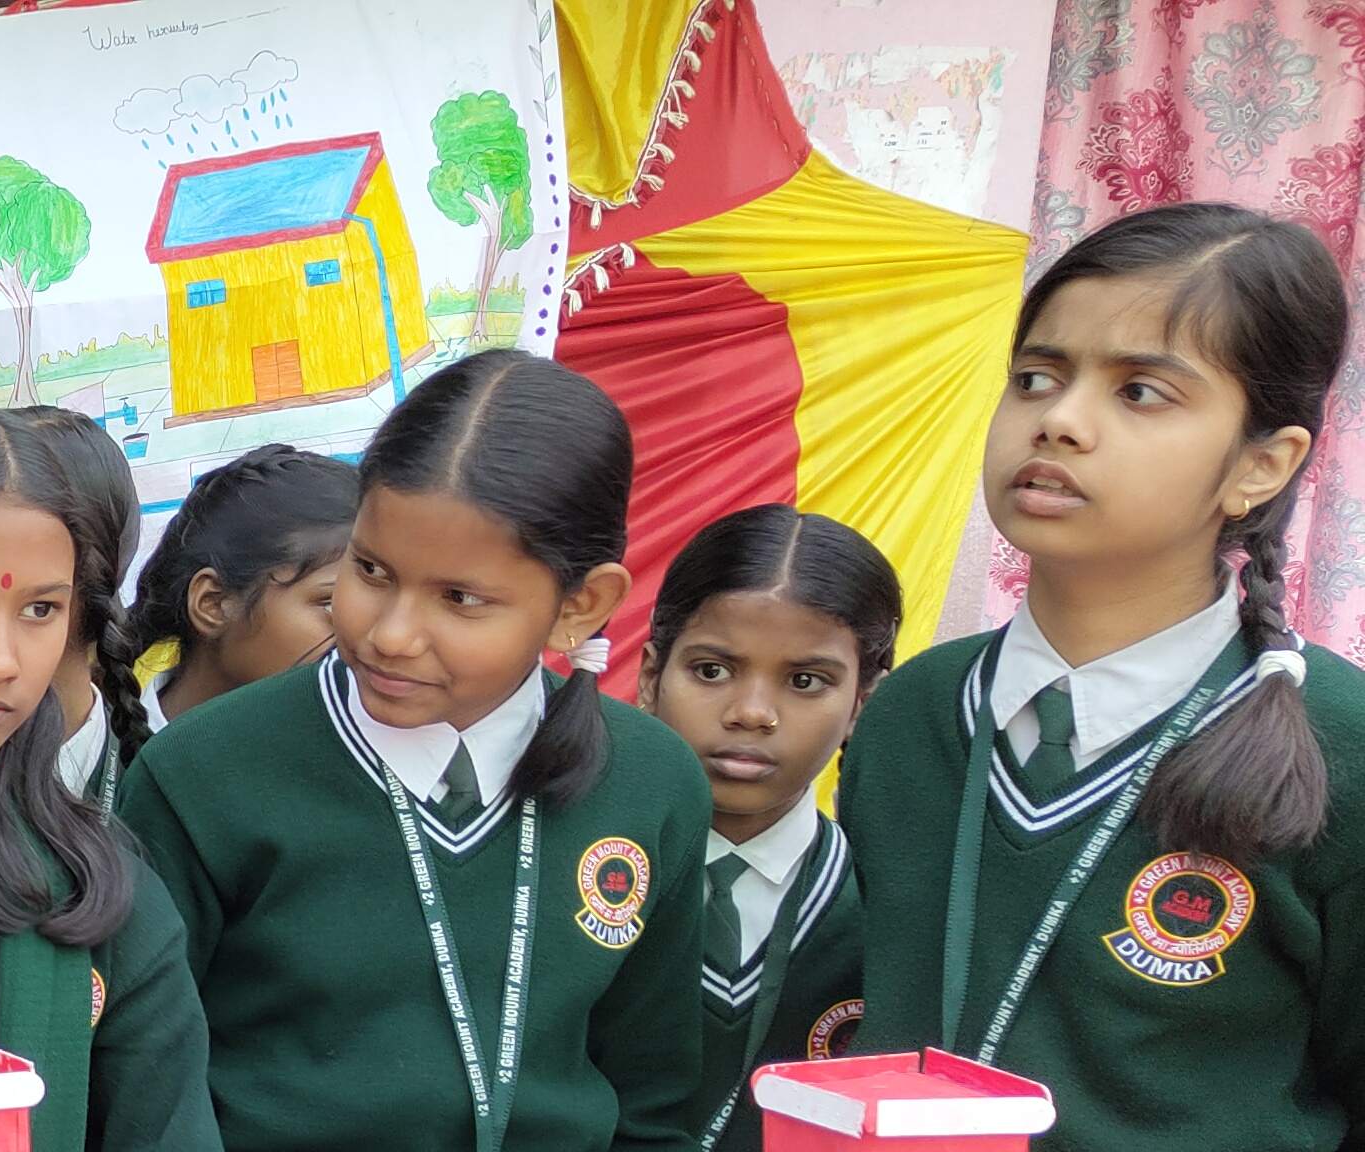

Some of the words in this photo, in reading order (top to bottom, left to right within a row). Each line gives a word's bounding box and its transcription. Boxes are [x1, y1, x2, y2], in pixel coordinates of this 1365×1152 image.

[1077, 828, 1114, 869] GREEN
[1104, 785, 1141, 829] MOUNT
[1175, 686, 1215, 728] DUMKA
[398, 813, 422, 851] MOUNT
[520, 816, 535, 854] GREEN
[410, 853, 433, 890] GREEN
[582, 853, 600, 890] GREEN
[595, 842, 631, 858] MOUNT
[514, 885, 530, 926] DUMKA
[1139, 857, 1182, 889] GREEN
[1225, 878, 1250, 932] ACADEMY
[430, 921, 449, 962] DUMKA
[583, 913, 640, 944] DUMKA
[986, 999, 1015, 1044] MOUNT
[1036, 900, 1069, 942] DUMKA
[1116, 937, 1213, 981] DUMKA
[504, 985, 521, 1027] MOUNT
[816, 1007, 847, 1036] GREEN
[457, 1021, 478, 1061] MOUNT
[500, 1028, 516, 1067] GREEN
[469, 1062, 488, 1102] GREEN
